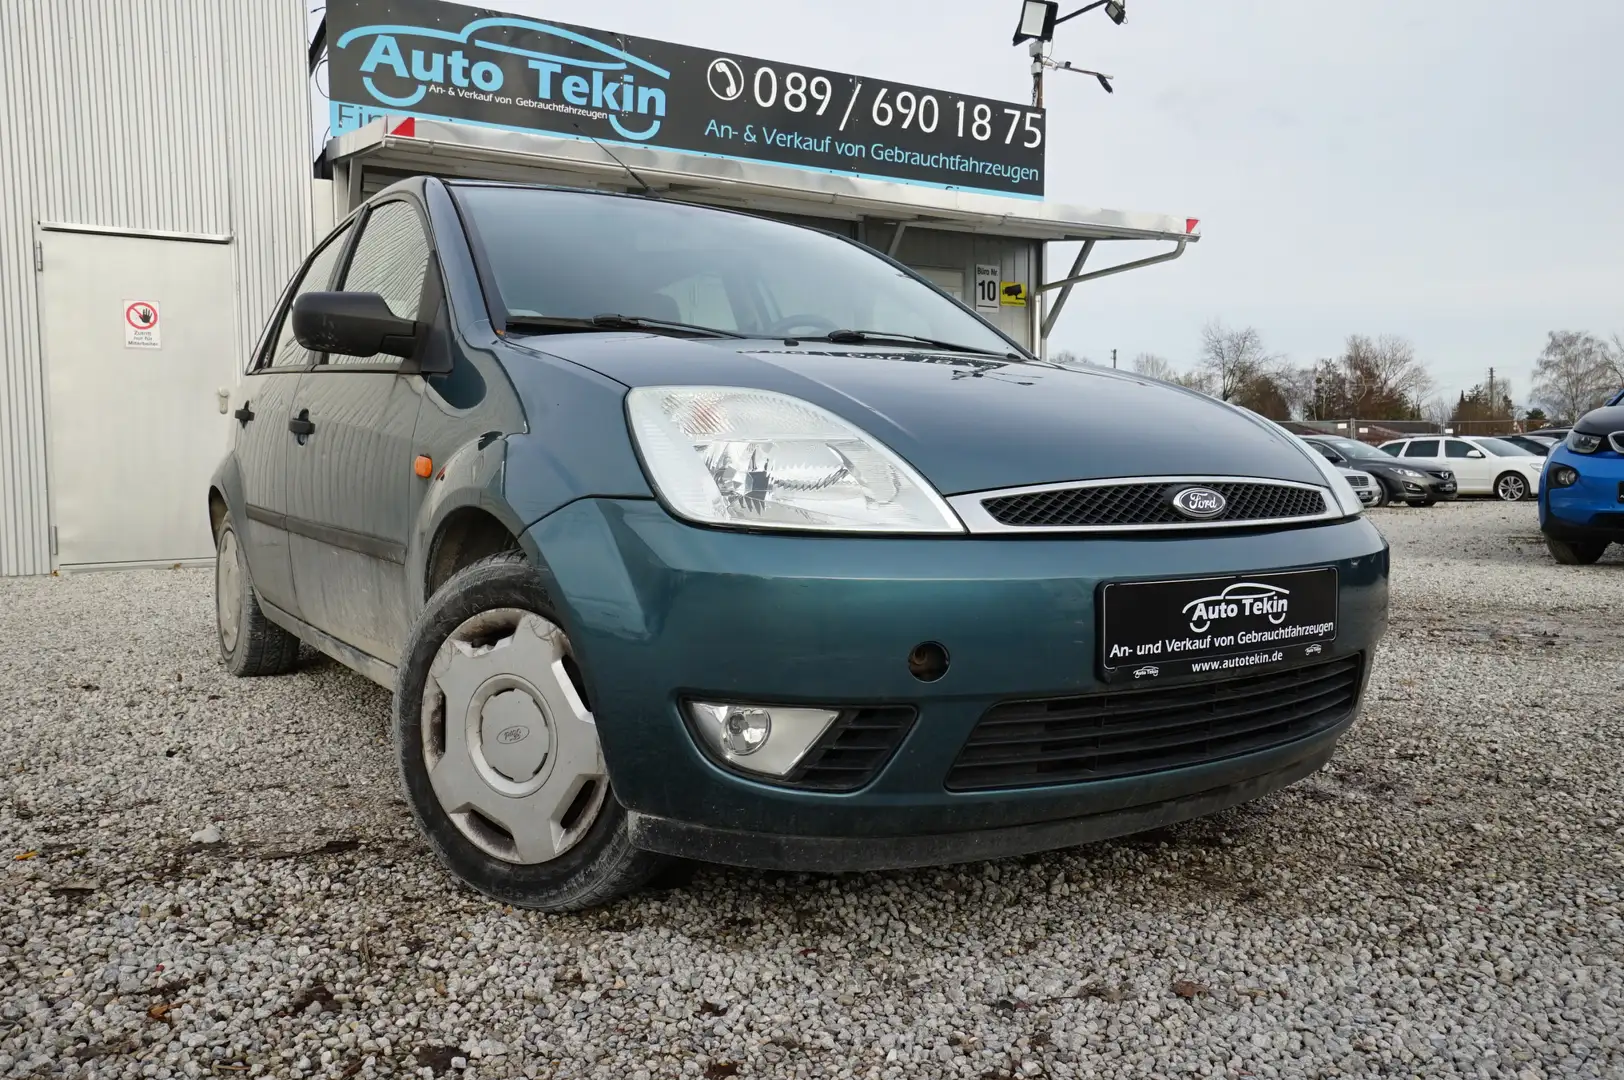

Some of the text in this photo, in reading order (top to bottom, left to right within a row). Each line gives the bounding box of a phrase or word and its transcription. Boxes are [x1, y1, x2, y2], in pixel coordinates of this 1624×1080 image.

[359, 34, 667, 117] Auto Tekin
[429, 84, 608, 120] An- & Verkauf von Gebrauchtfahrzeugen
[753, 66, 832, 116] 089
[872, 88, 939, 134] 690
[956, 100, 992, 141] 18
[1003, 107, 1043, 149] 75
[704, 118, 1039, 184] An- & Verkauf von Gebrauchtfahrzeugen
[978, 280, 996, 301] 10
[1189, 493, 1217, 509] Ford
[1192, 596, 1288, 621] Auto Tekin
[1109, 621, 1334, 658] An- und Verkauf von Gebrauchtfahrzeugen
[1192, 650, 1283, 673] www.autotekin.de
